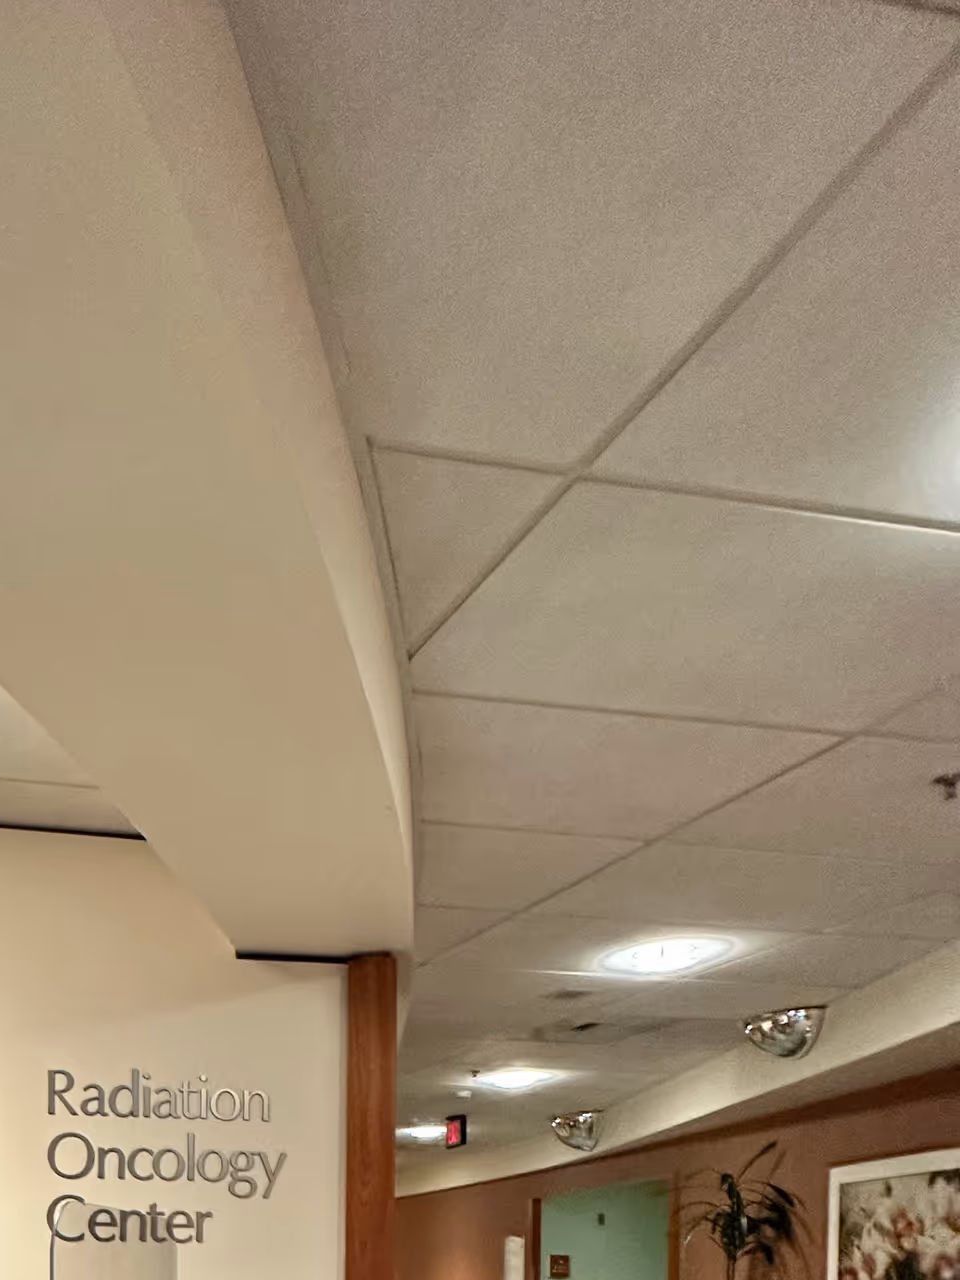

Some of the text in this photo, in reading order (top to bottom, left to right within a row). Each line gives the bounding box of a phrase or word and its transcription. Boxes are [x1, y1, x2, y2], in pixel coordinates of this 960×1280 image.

[47, 1067, 270, 1122] Radiation
[47, 1132, 288, 1199] Oncology
[46, 1194, 213, 1243] Center
